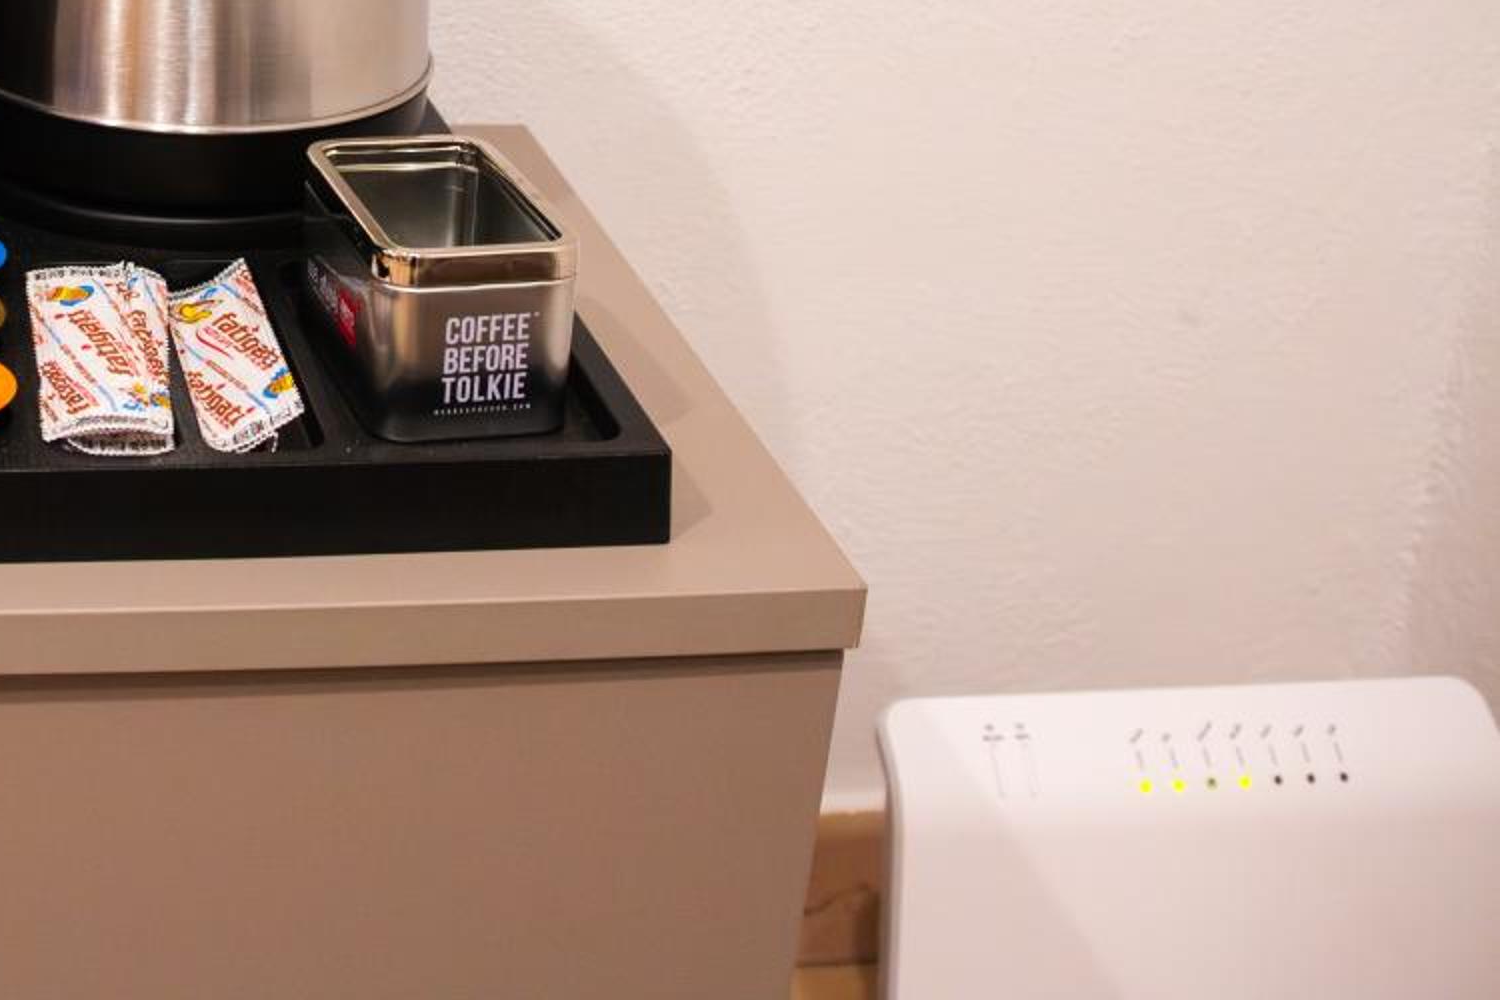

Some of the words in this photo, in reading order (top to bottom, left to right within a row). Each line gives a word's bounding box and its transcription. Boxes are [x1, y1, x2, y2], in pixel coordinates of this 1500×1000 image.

[445, 312, 531, 345] COFFEE
[443, 343, 529, 375] BEFORE
[441, 371, 527, 404] TOLKIE
